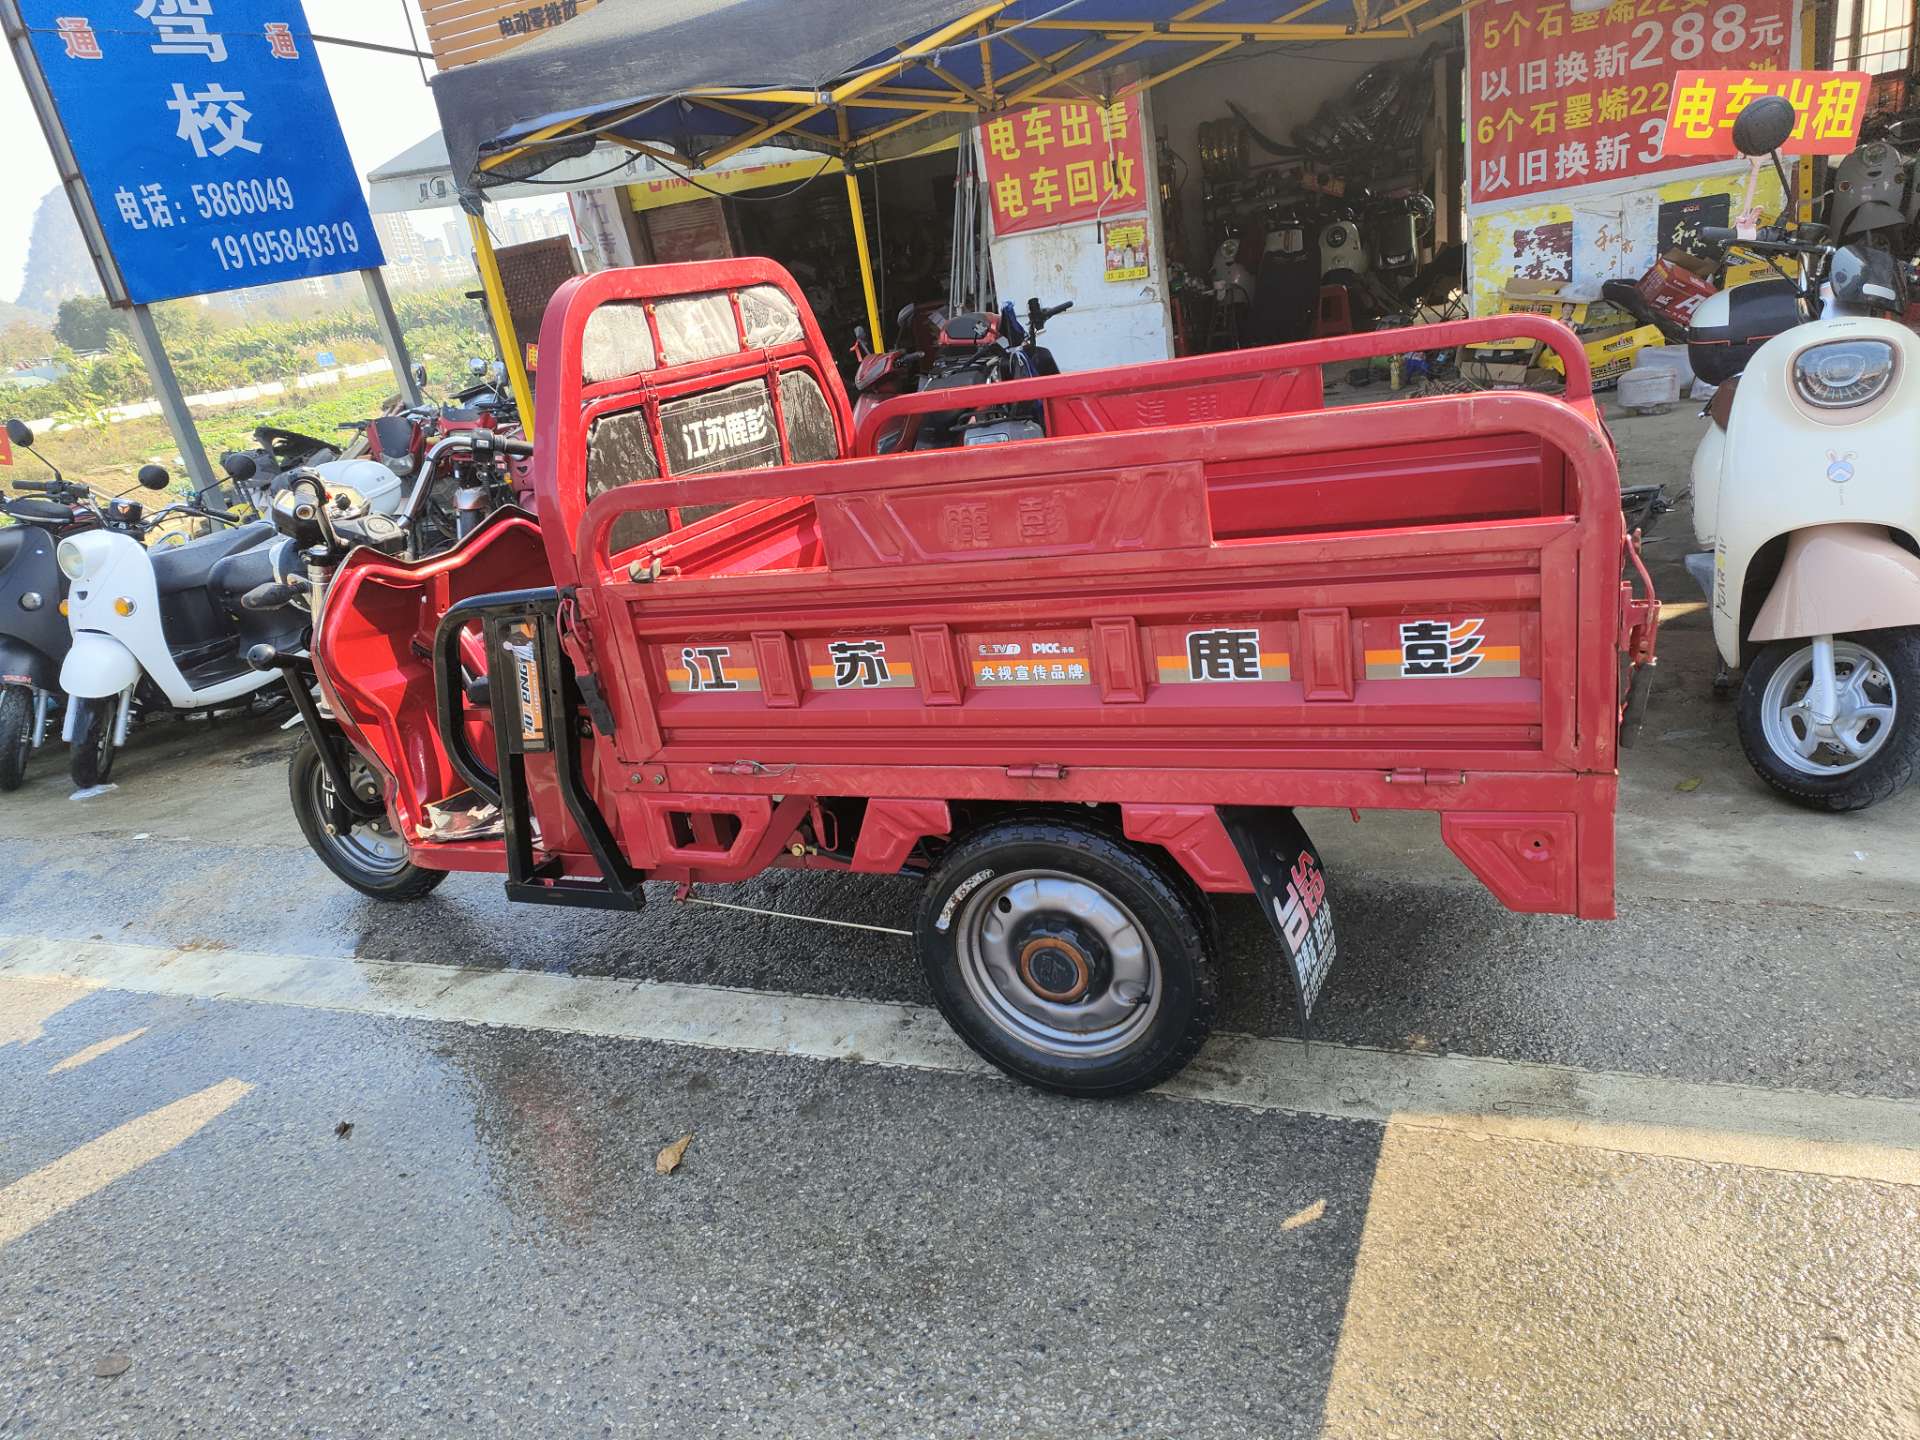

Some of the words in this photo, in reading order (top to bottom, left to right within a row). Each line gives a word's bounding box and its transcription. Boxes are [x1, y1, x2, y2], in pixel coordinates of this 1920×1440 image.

[988, 102, 1129, 160] 电车出售
[1480, 118, 1692, 192] 以旧换新3
[996, 151, 1137, 218] 电车回收
[211, 221, 359, 270] 19195849319
[682, 404, 767, 460] 江苏鹿彭
[981, 664, 1084, 681] 央视宣传品牌
